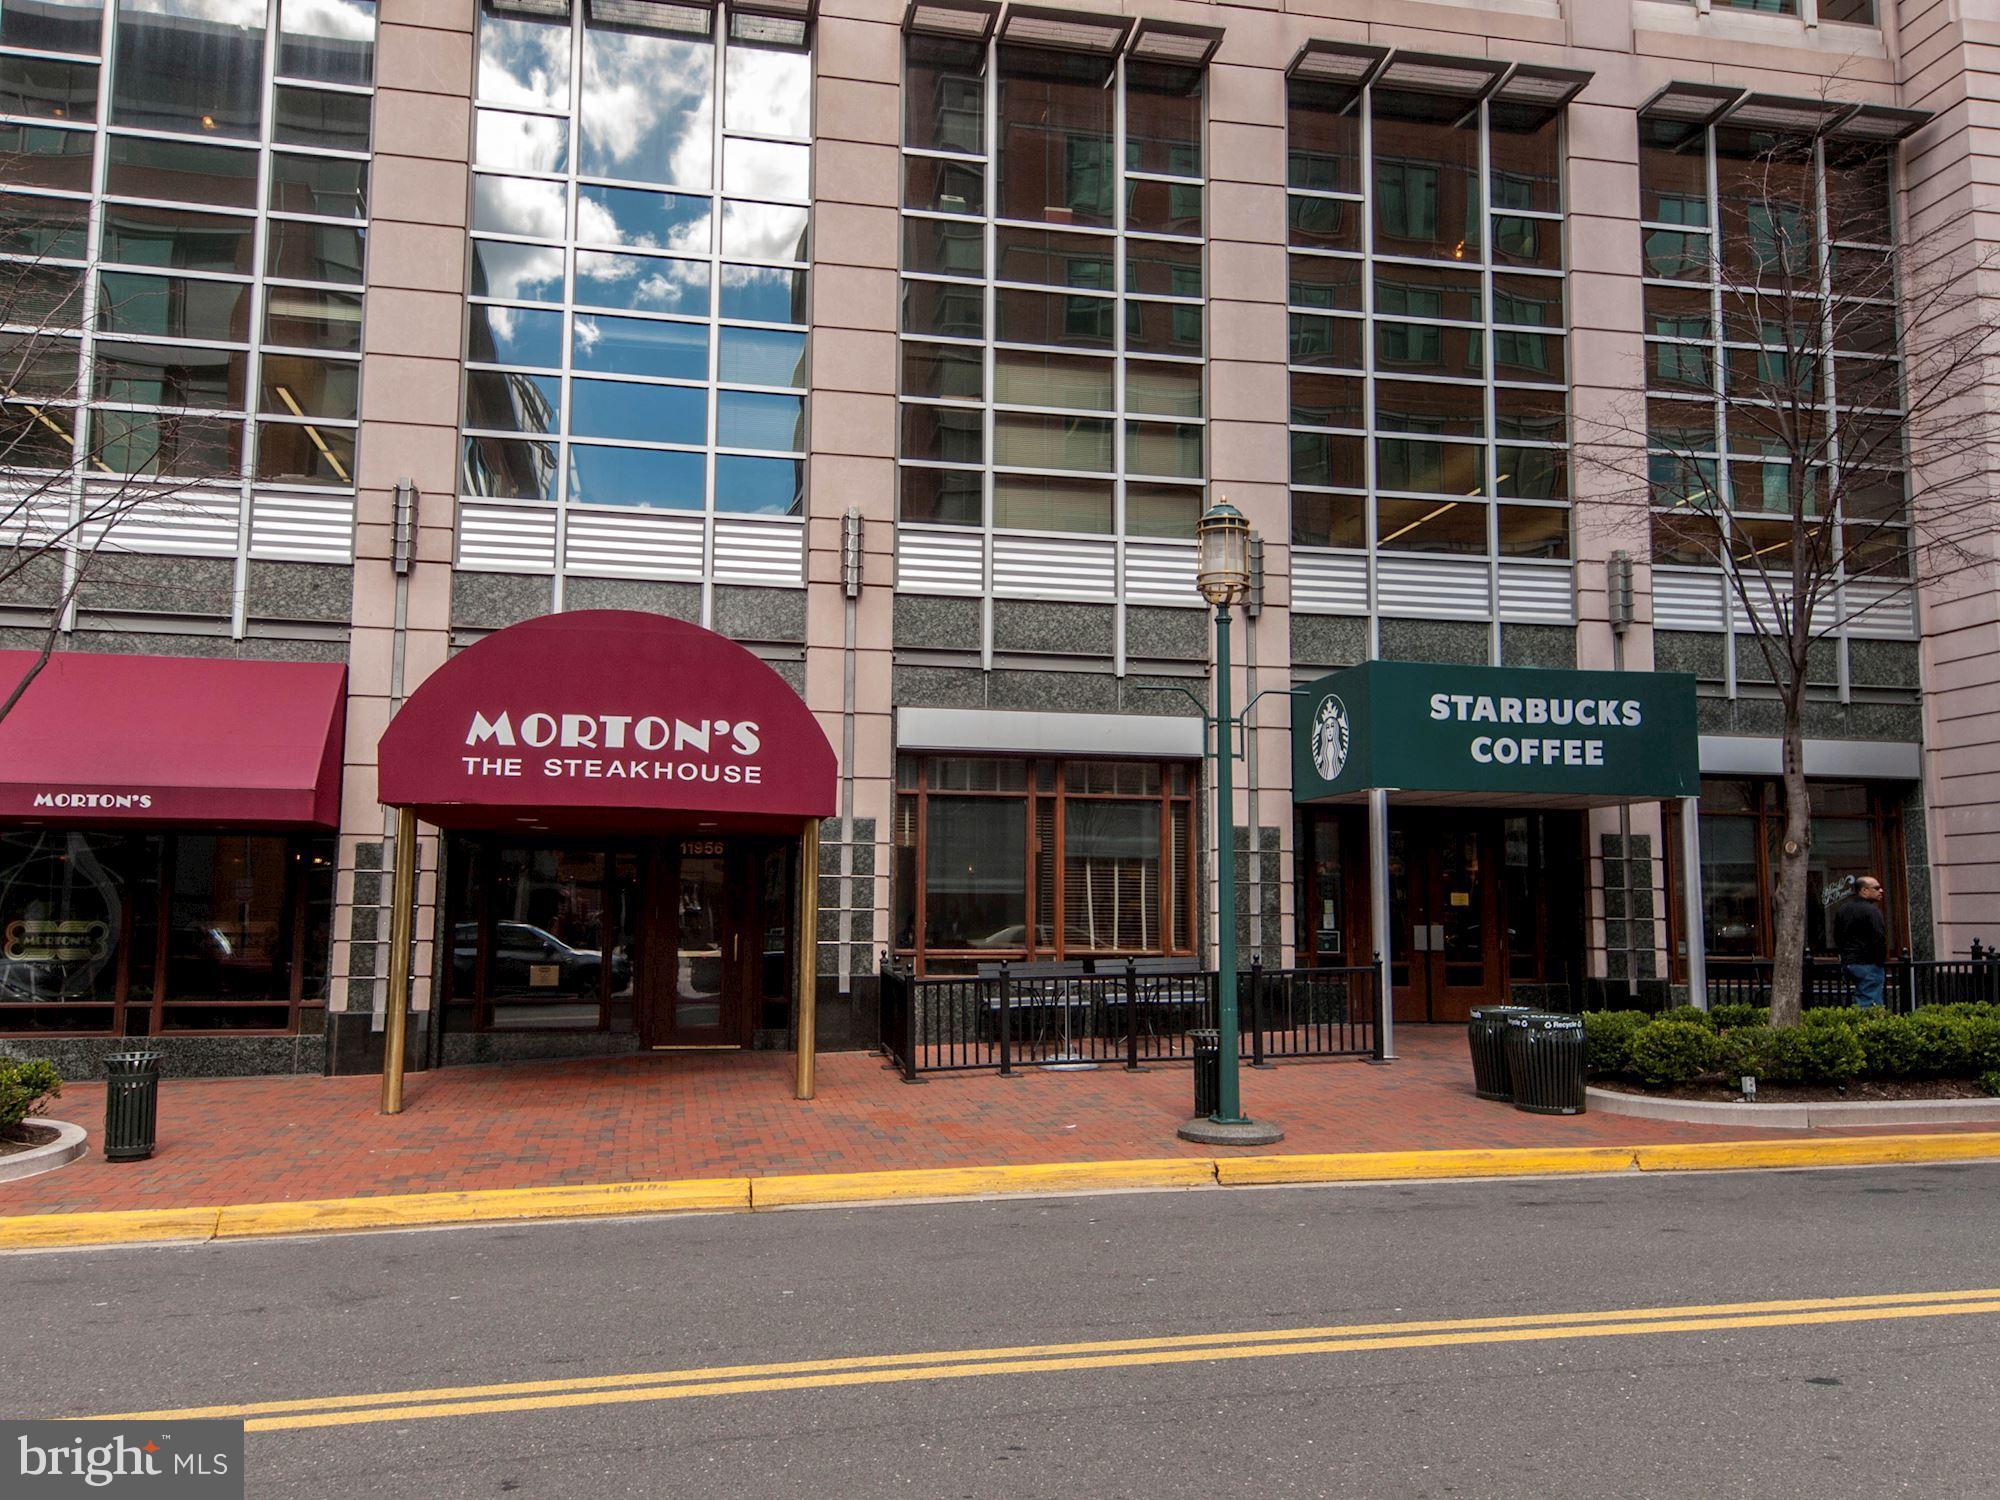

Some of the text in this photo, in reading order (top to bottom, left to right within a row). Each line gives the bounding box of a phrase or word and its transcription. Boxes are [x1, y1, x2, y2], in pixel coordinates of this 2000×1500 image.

[1430, 693, 1642, 727] STARBUCKS
[465, 710, 761, 756] MORTON'S
[1470, 736, 1604, 766] COFFEE
[462, 756, 762, 784] THE STEAKHOUSE
[33, 793, 152, 808] MORTON'S
[680, 841, 724, 854] 11956
